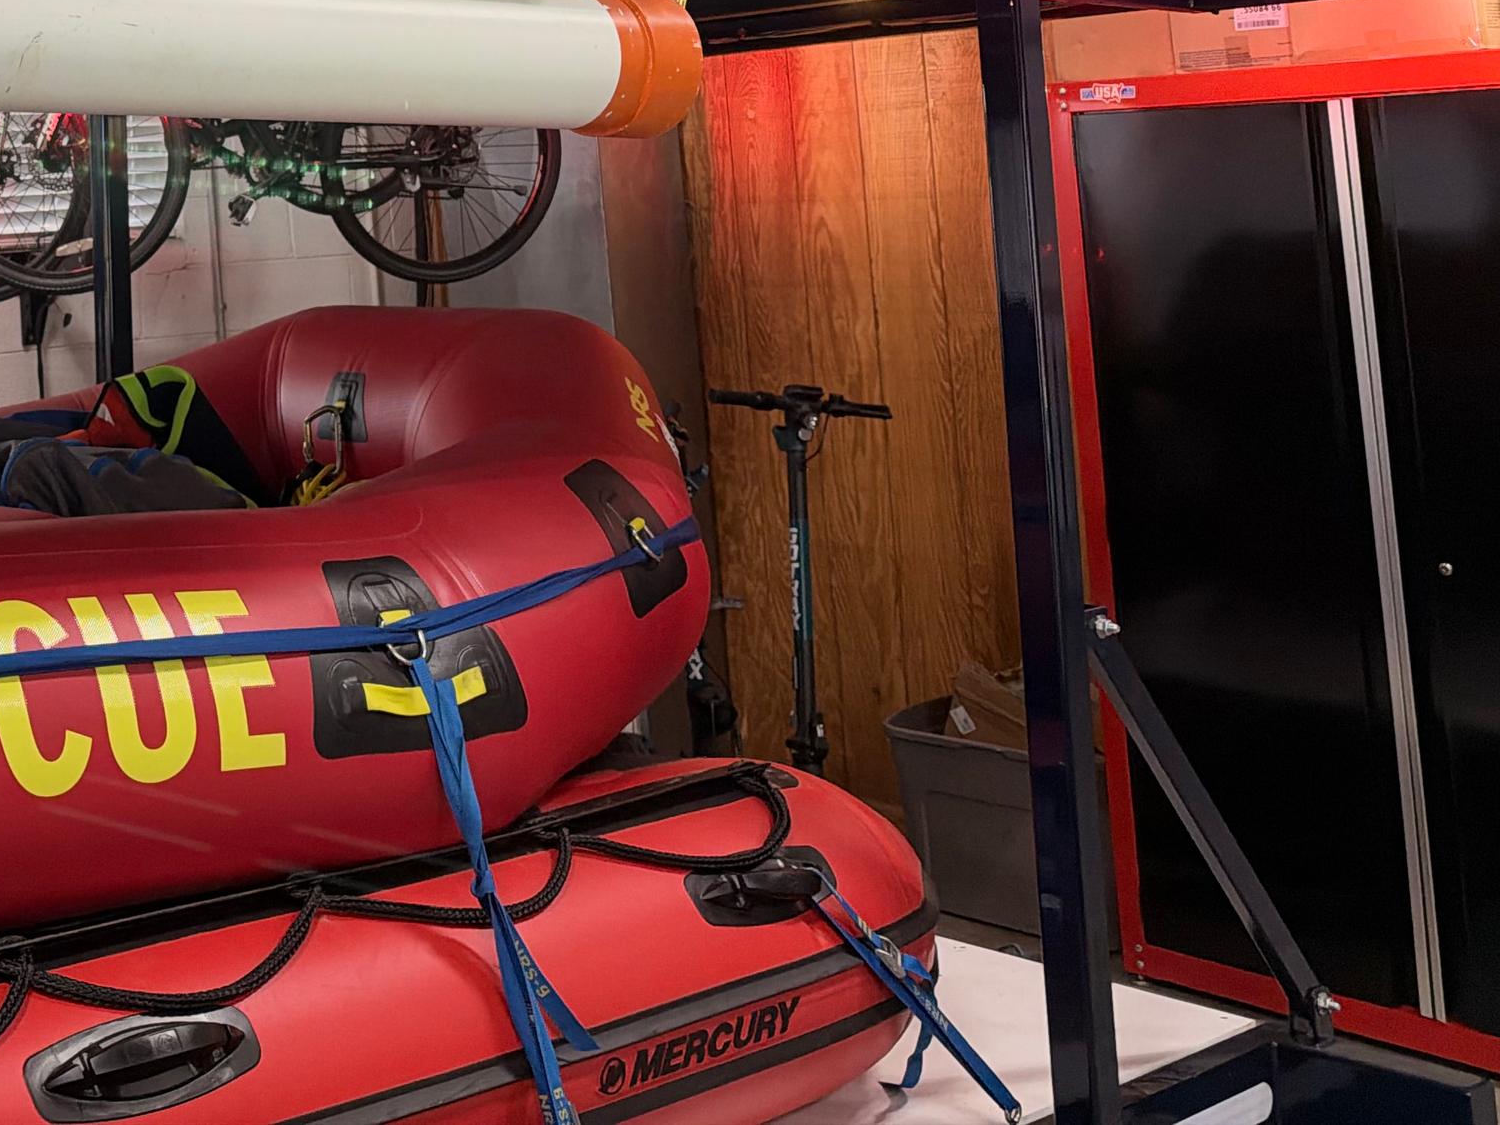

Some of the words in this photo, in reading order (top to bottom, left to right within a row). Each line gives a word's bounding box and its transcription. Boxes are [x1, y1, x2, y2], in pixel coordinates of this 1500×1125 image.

[1094, 86, 1120, 99] USA
[624, 376, 659, 443] NRS
[629, 996, 801, 1088] MERCURY
